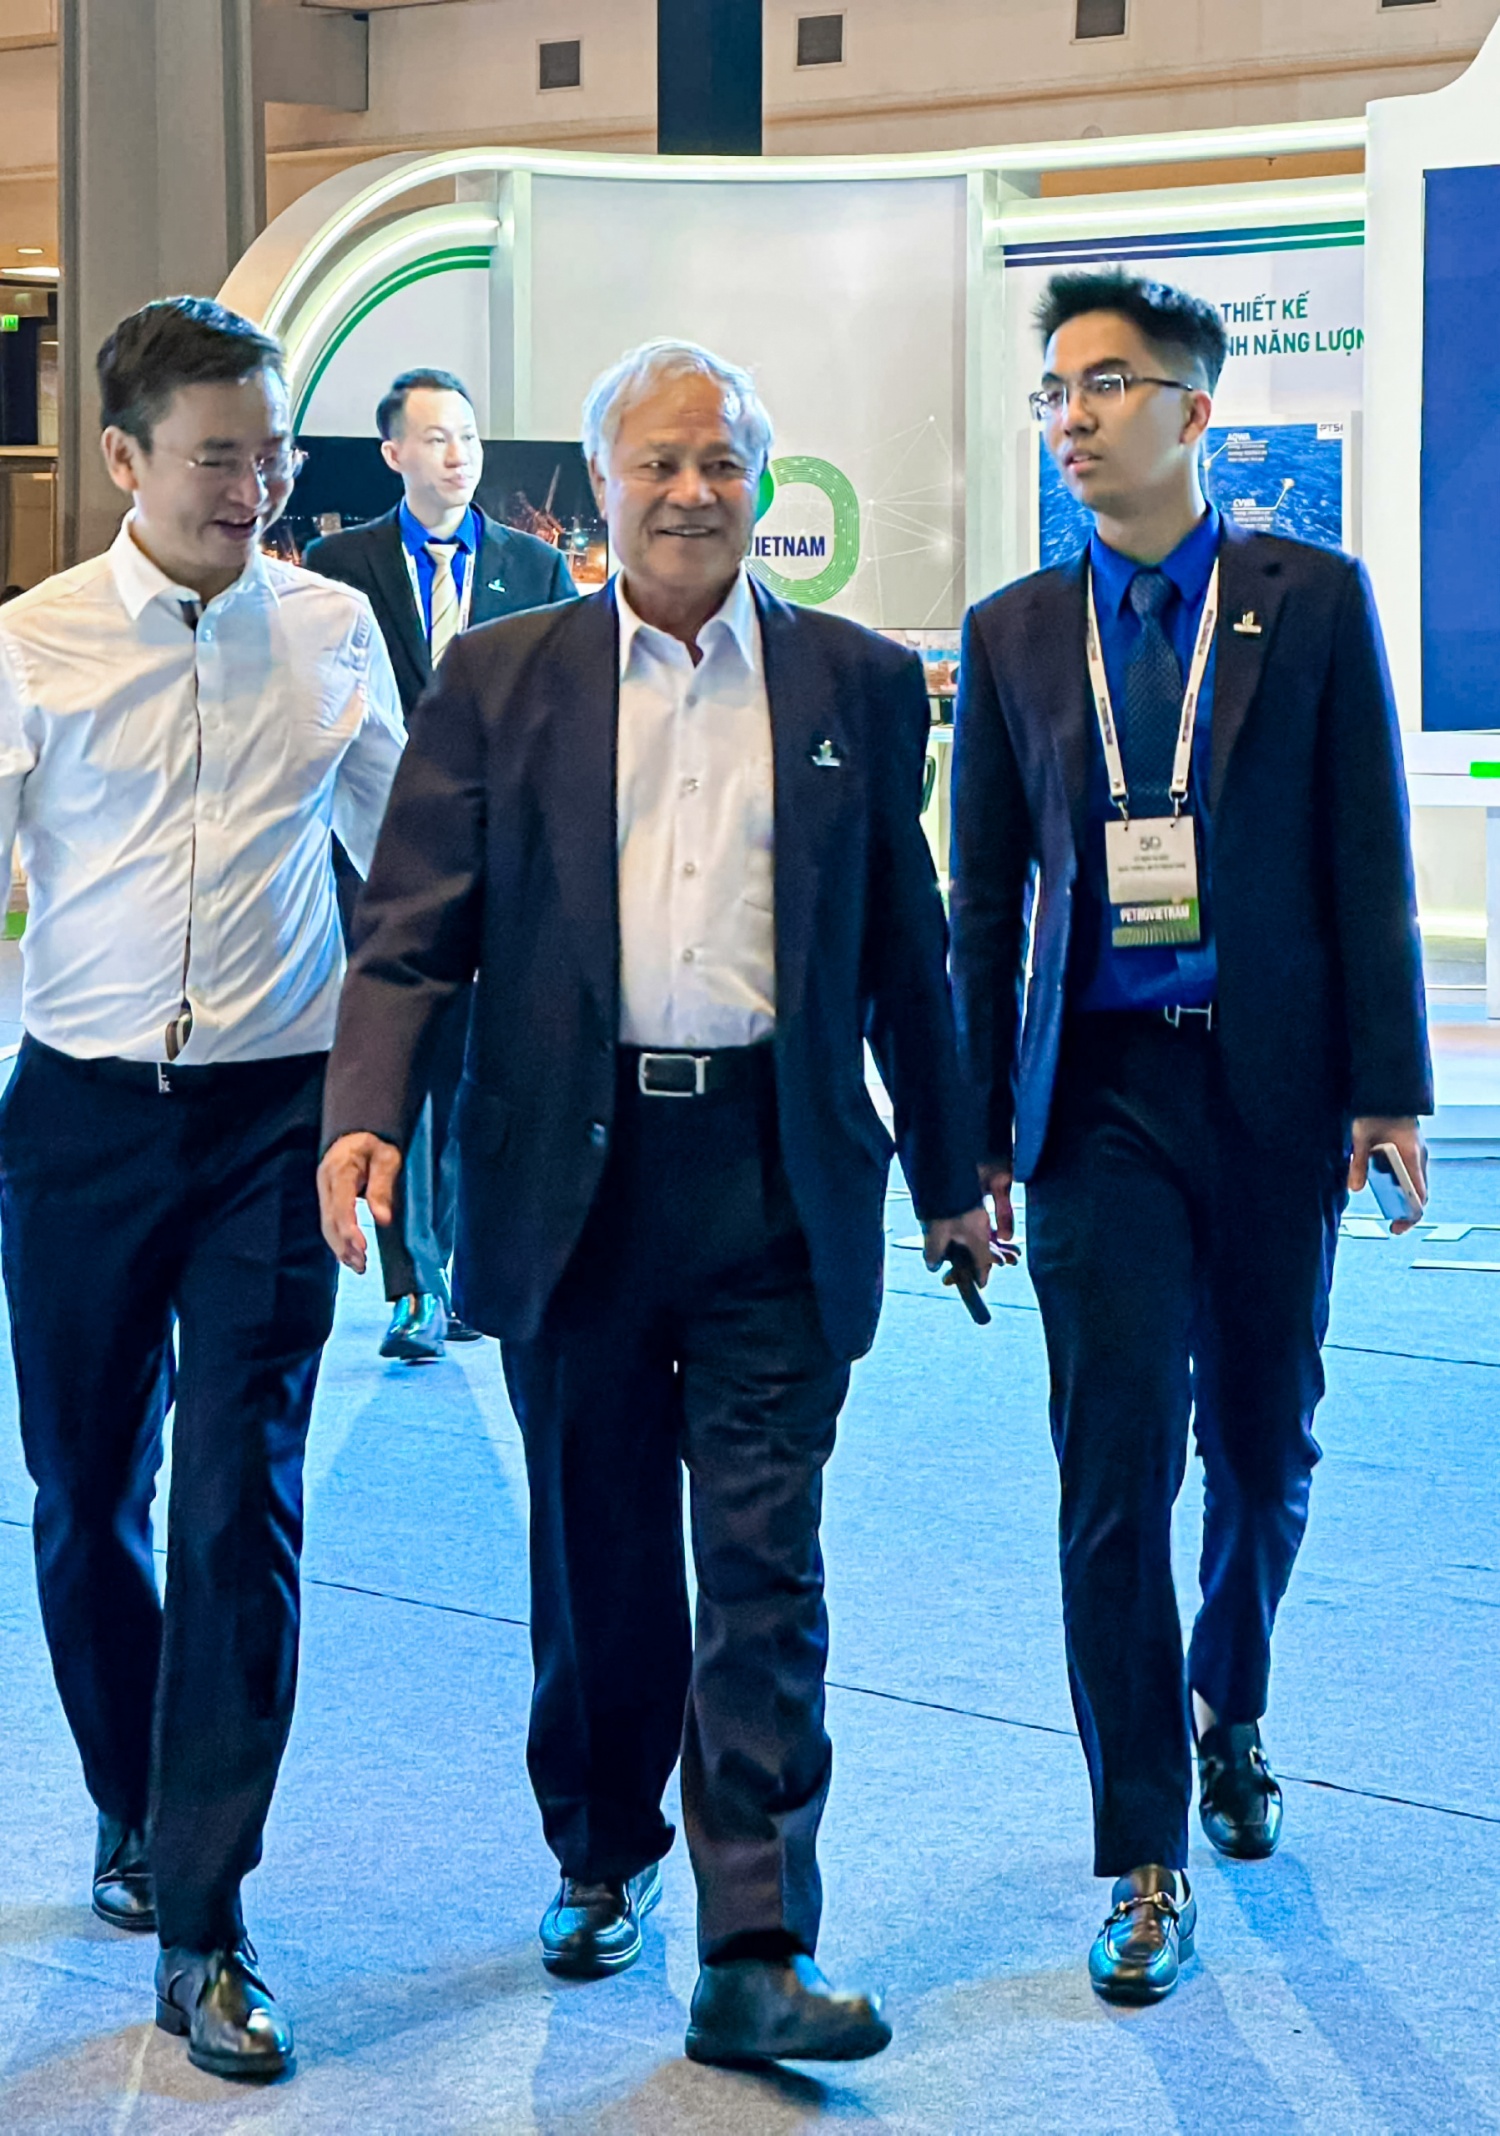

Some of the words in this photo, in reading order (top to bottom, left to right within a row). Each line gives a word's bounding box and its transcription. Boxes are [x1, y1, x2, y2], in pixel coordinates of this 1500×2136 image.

[1220, 293, 1277, 323] THIẾT
[1282, 290, 1310, 320] KẾ
[1253, 328, 1310, 356] NĂNG
[755, 535, 826, 557] IETNAM
